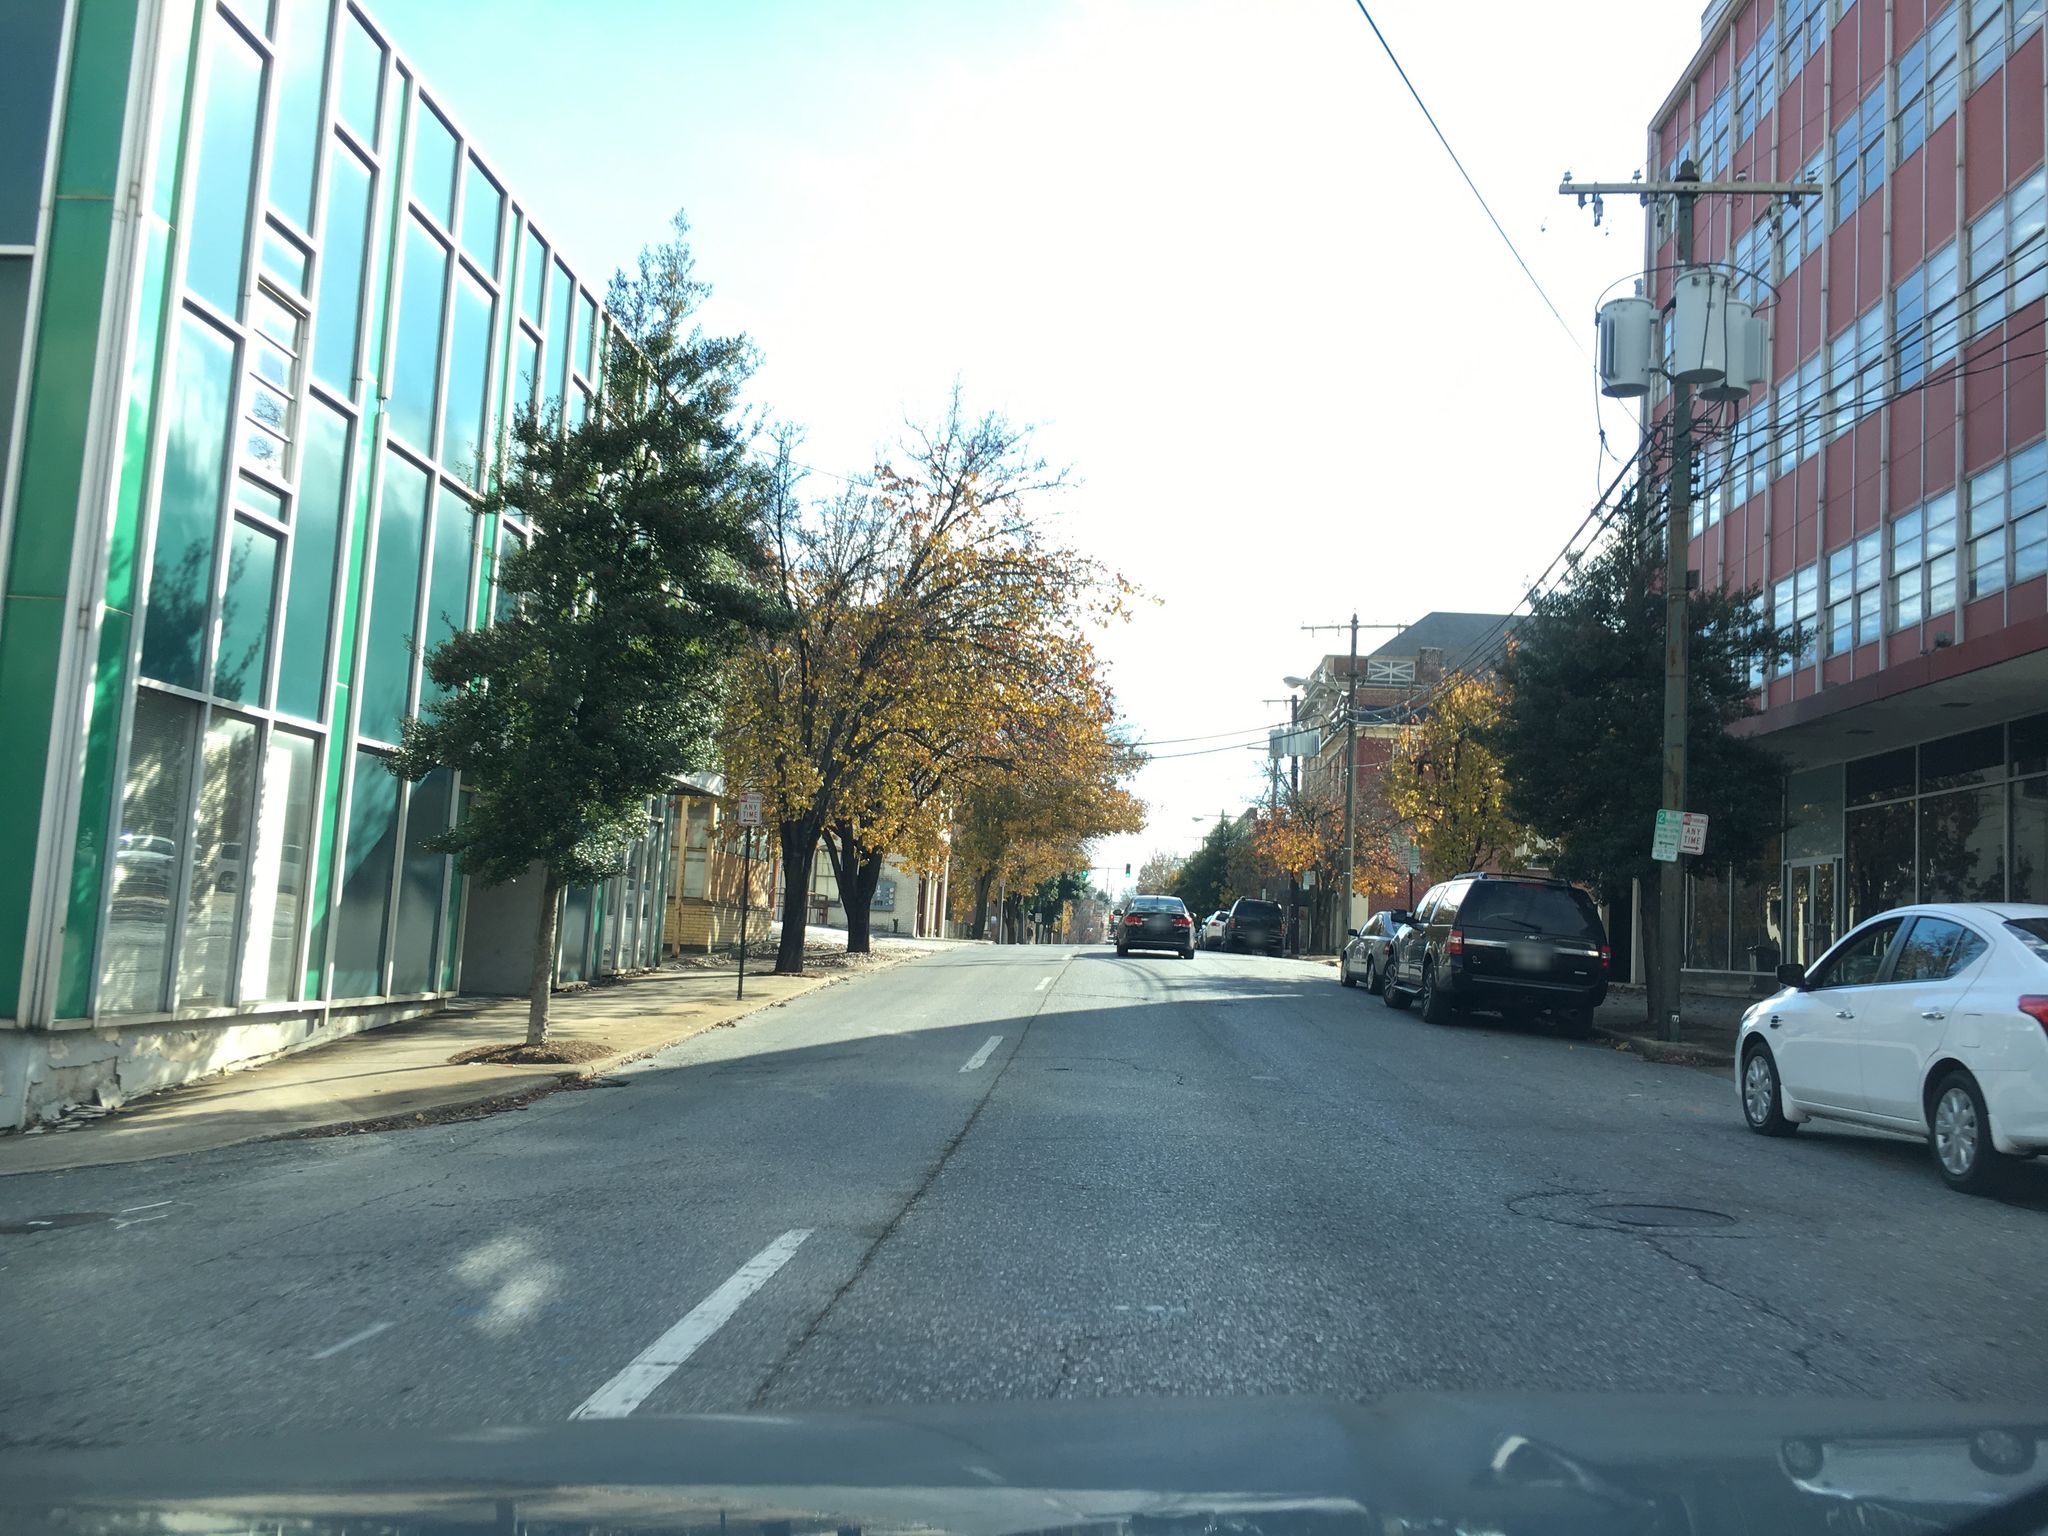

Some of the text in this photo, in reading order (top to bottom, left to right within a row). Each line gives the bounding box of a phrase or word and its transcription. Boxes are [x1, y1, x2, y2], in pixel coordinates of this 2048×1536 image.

[1658, 812, 1665, 824] 2
[1686, 827, 1701, 836] ANY
[1684, 836, 1701, 845] TIME
